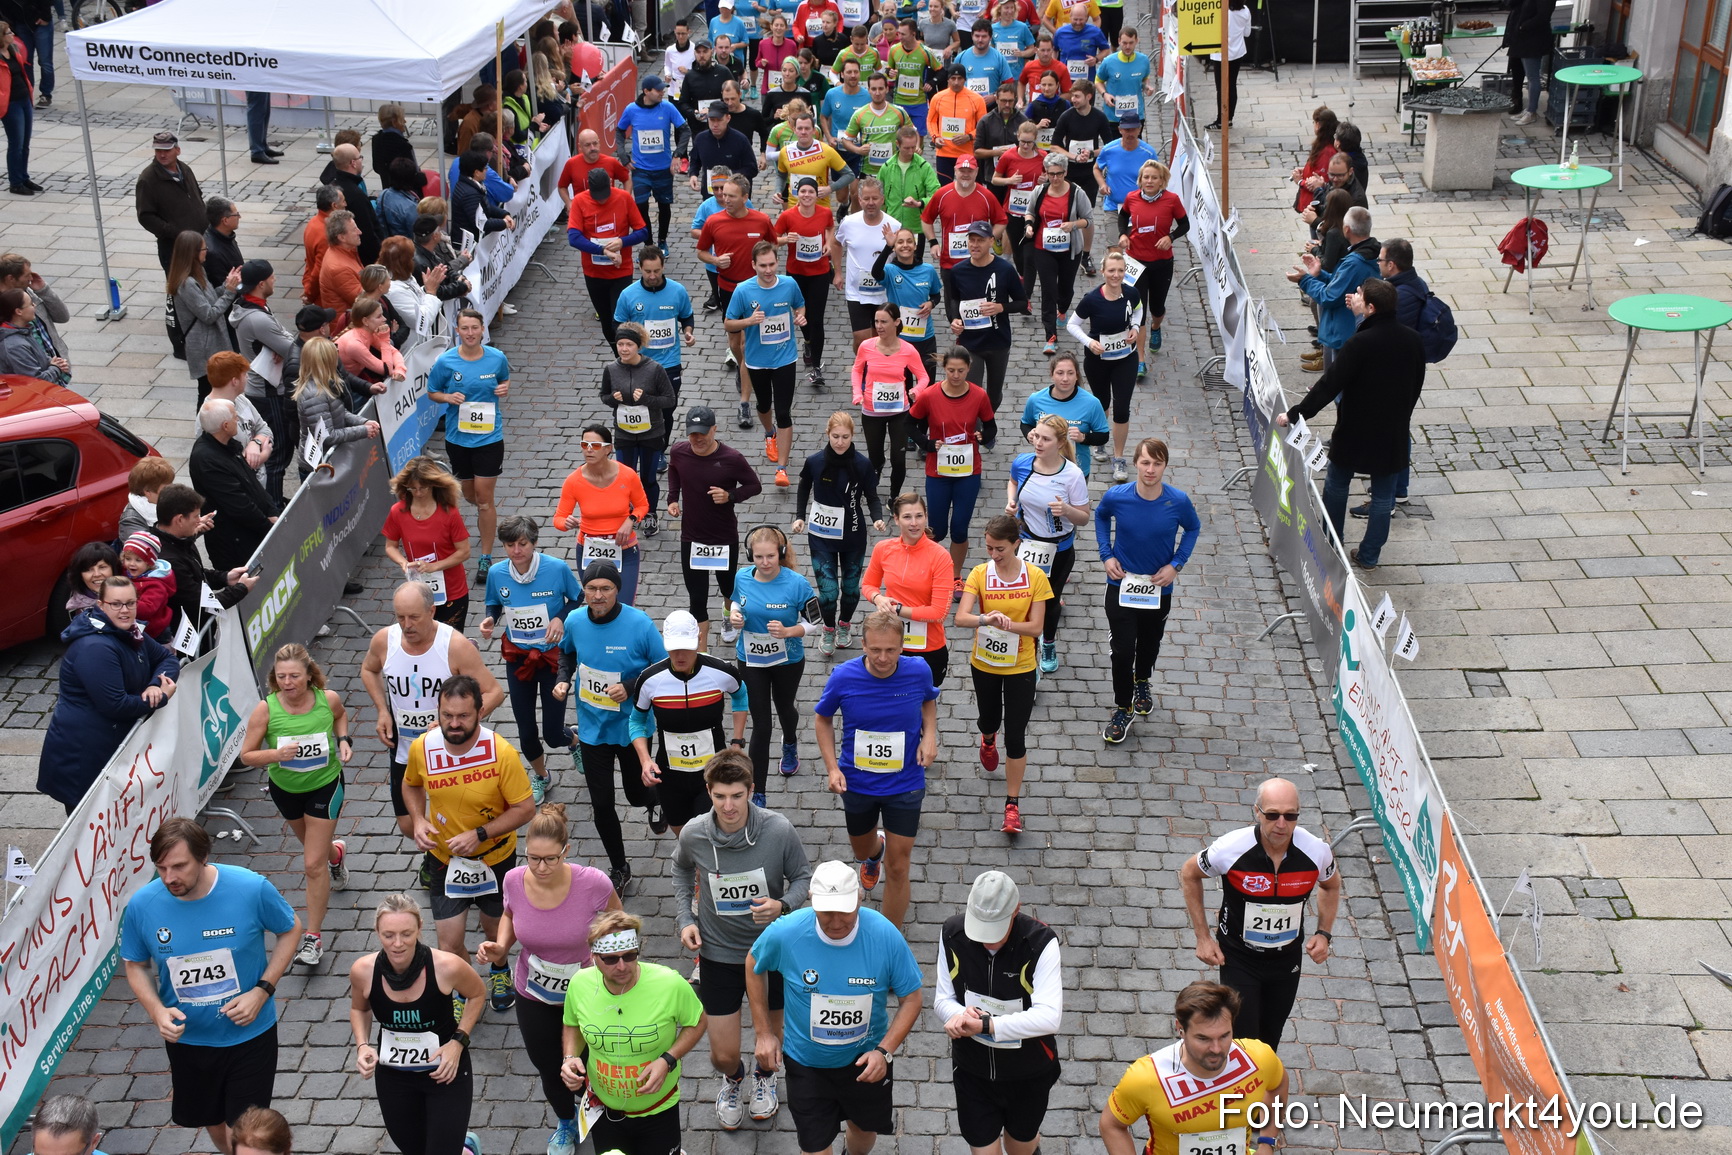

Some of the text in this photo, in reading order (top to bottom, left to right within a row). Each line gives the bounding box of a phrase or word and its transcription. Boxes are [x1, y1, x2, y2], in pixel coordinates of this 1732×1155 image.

[1192, 13, 1215, 25] lauf
[86, 42, 278, 69] BMW ConnectedDrive
[89, 60, 144, 76] Vernetzt,
[147, 67, 164, 75] um
[168, 67, 188, 78] frei
[207, 69, 236, 81] sein.
[1070, 66, 1086, 74] 2764
[902, 81, 915, 89] 418
[946, 123, 960, 133] 305
[642, 137, 661, 145] 2143
[871, 149, 889, 158] 2727
[788, 154, 826, 169] MAX BÖGL
[1046, 234, 1067, 244] 2543
[800, 243, 820, 253] 2525
[963, 307, 982, 319] 239
[764, 322, 787, 334] 2941
[905, 316, 921, 327] 171
[649, 327, 673, 339] 2938
[1104, 339, 1127, 352] 2183
[876, 391, 901, 402] 2934
[470, 411, 484, 422] 84
[623, 414, 642, 424] 180
[945, 454, 966, 465] 100
[813, 512, 839, 526] 2037
[587, 546, 617, 559] 2342
[696, 546, 724, 557] 2917
[1022, 550, 1051, 565] 2113
[531, 590, 555, 598] BOCK
[1125, 582, 1156, 595] 2602
[984, 590, 1032, 601] MAX BÖGL
[246, 561, 300, 656] BOCK
[512, 616, 545, 630] 2552
[181, 627, 193, 650] swn
[1402, 631, 1416, 656] swn
[749, 641, 780, 656] 2945
[985, 638, 1008, 654] 268
[587, 678, 609, 694] 164
[402, 713, 436, 729] 2433
[680, 744, 697, 757] 81
[866, 743, 893, 759] 135
[428, 767, 500, 791] MAX BÖGL
[452, 869, 488, 885] 2631
[718, 884, 761, 900] 2079
[1252, 916, 1291, 932] 2141
[203, 927, 236, 939] BOCK
[179, 964, 227, 987] 2743
[533, 970, 572, 992] 2778
[848, 977, 877, 986] BOCK
[392, 1009, 421, 1023] RUN
[819, 1010, 864, 1026] 2568
[1494, 997, 1518, 1046] Neumarkts
[39, 986, 98, 1076] Service-Line:
[826, 1029, 856, 1038] Wolfgang
[388, 1045, 430, 1065] 2724
[1172, 1076, 1264, 1125] MAX ÖGL
